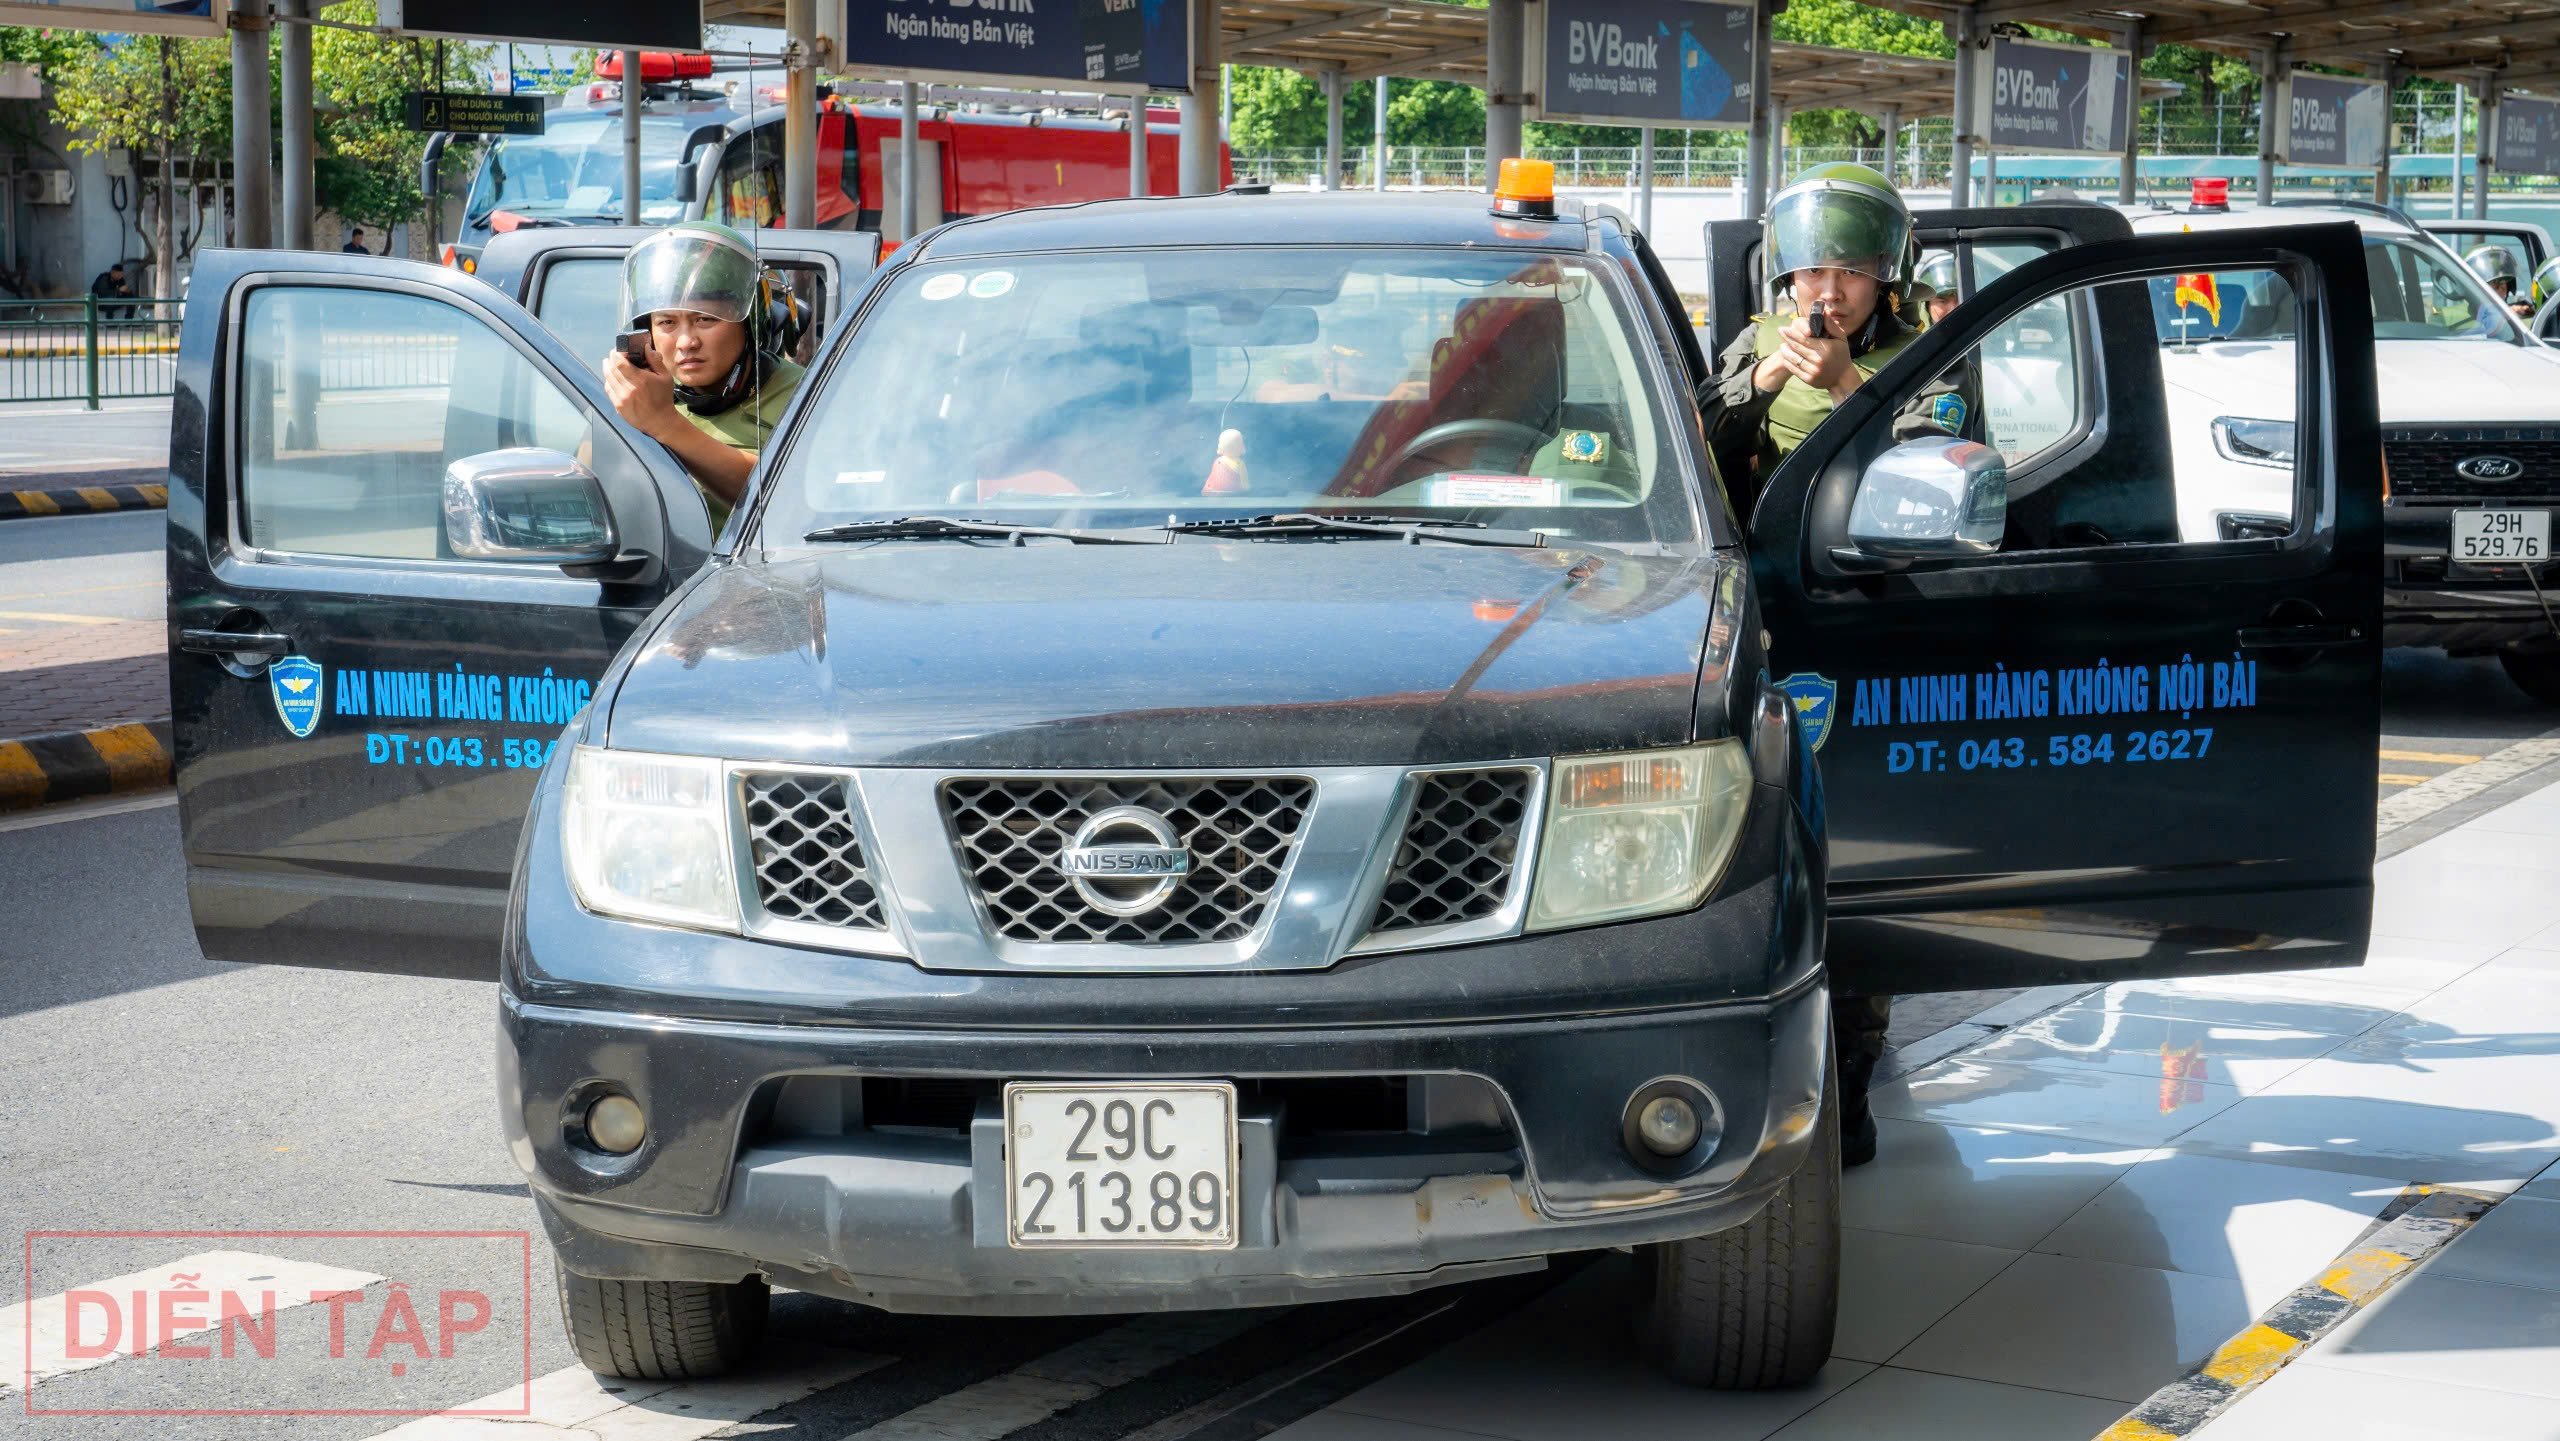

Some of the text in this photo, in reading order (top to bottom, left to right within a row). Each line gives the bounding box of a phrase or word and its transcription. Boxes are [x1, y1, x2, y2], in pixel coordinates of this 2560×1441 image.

[886, 12, 1034, 49] Ngân hàng Bản Việt
[1569, 20, 1658, 69] BVBank
[1568, 73, 1657, 96] Ngân hàng Bản Việt
[1995, 67, 2060, 110] BVBank
[449, 111, 466, 121] CHO
[493, 100, 504, 109] XE
[2292, 97, 2336, 132] BVBank
[1055, 162, 1063, 186] 1
[1988, 422, 2060, 433] ERNATIONAL
[2474, 459, 2511, 476] Ford
[2482, 513, 2522, 534] 29H
[2464, 536, 2538, 557] 529.76
[336, 662, 591, 725] AN NINH HÀNG KHÔNG
[1852, 651, 2257, 726] AN NINH HÀNG KHÔNG NỘI BÀI
[2126, 728, 2214, 762] 2627
[1074, 855, 1174, 870] NISSAN
[1065, 1098, 1175, 1161] 29C
[1022, 1171, 1221, 1233] 213.89
